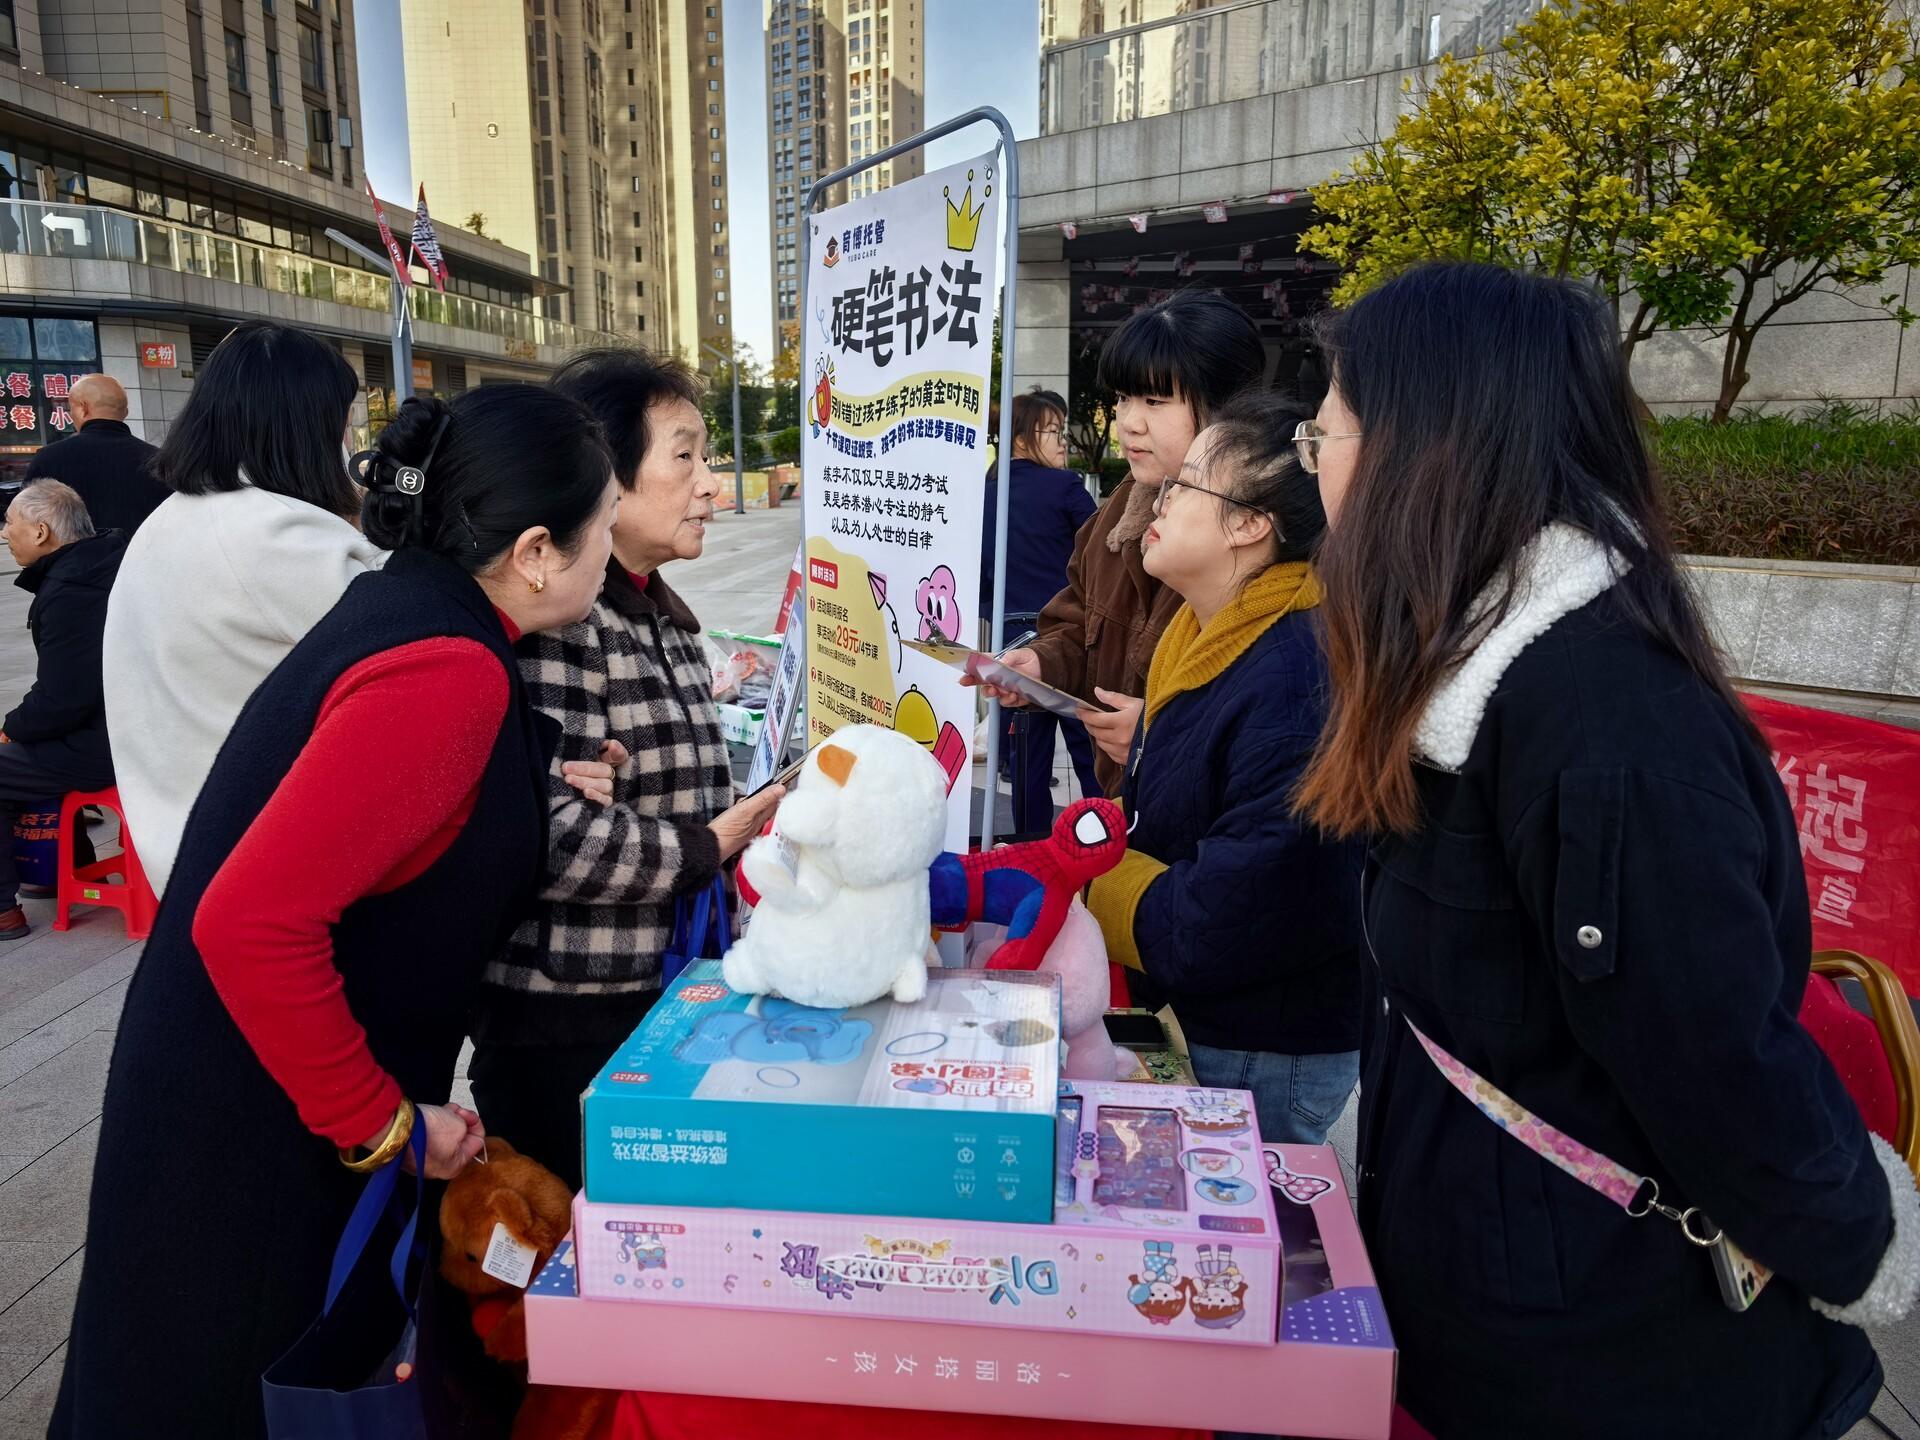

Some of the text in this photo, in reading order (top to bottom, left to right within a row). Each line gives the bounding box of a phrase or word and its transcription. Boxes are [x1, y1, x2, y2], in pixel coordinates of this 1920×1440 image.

[842, 219, 886, 255] 育博托管
[831, 259, 983, 368] 硬笔书法
[831, 377, 980, 428] 别错过孩子练字的黄金时期
[823, 465, 949, 496] 练字不仅仅只是助力考试
[823, 490, 949, 524] 更是培养潜心专注的静气
[831, 516, 934, 551] 以及为人处世的自律
[611, 1142, 728, 1165] 感统益智游戏
